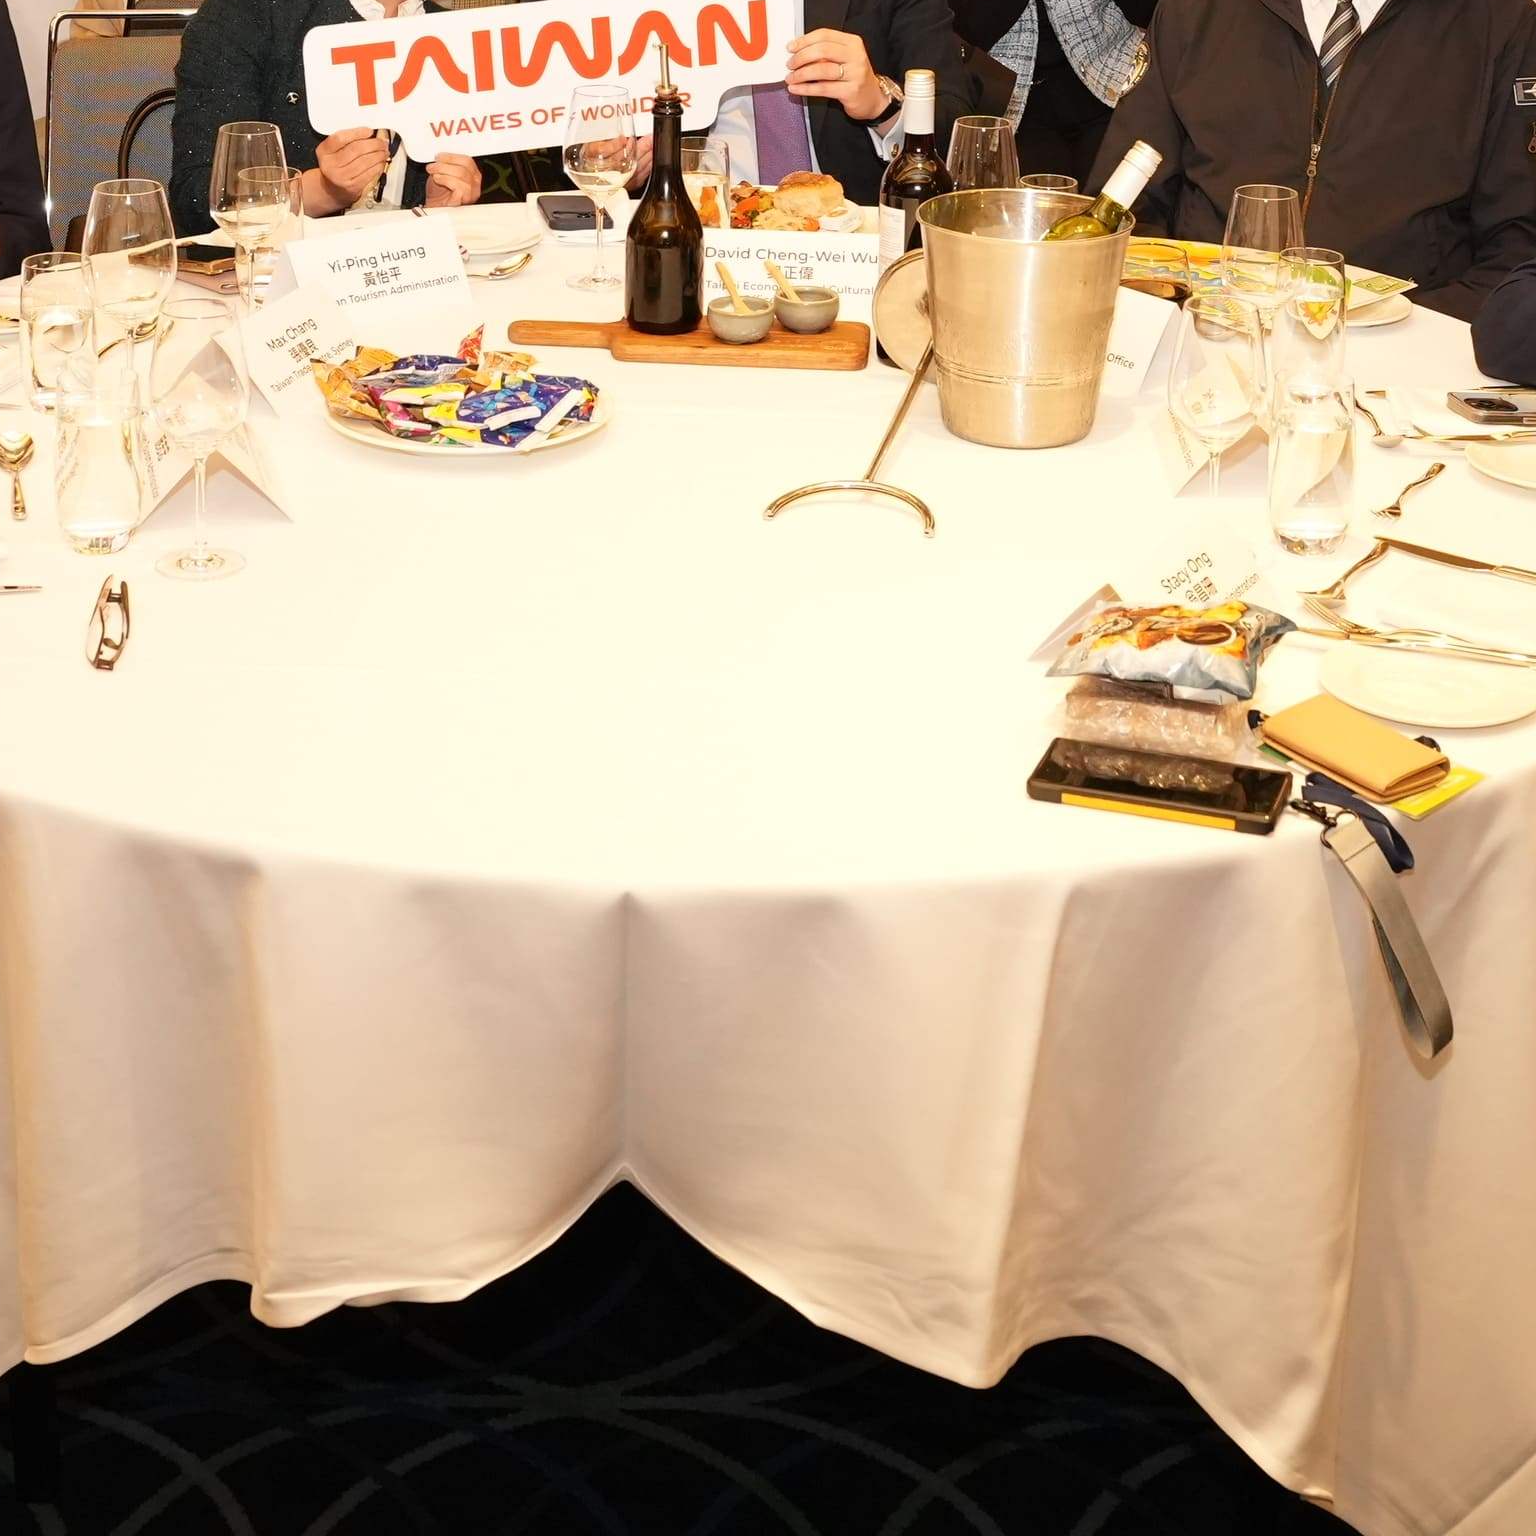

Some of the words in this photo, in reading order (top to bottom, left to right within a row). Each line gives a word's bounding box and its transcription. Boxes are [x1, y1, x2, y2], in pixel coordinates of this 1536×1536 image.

[331, 0, 768, 106] TAIWAN
[429, 112, 523, 138] WAVES
[531, 106, 566, 125] OF
[571, 92, 692, 121] WONDR
[327, 253, 378, 274] Yi-Ping
[381, 245, 426, 263] Huang
[705, 247, 750, 260] David
[756, 248, 846, 264] Cheng-Wei
[851, 252, 878, 264] Wu
[349, 289, 388, 306] Tourism
[390, 273, 459, 296] Administration
[363, 267, 403, 288] 黃怡平
[266, 336, 287, 352] Max
[285, 318, 318, 340] Chang
[1106, 352, 1135, 369] Office
[1160, 568, 1192, 594] Stacy
[1187, 552, 1213, 574] Ong
